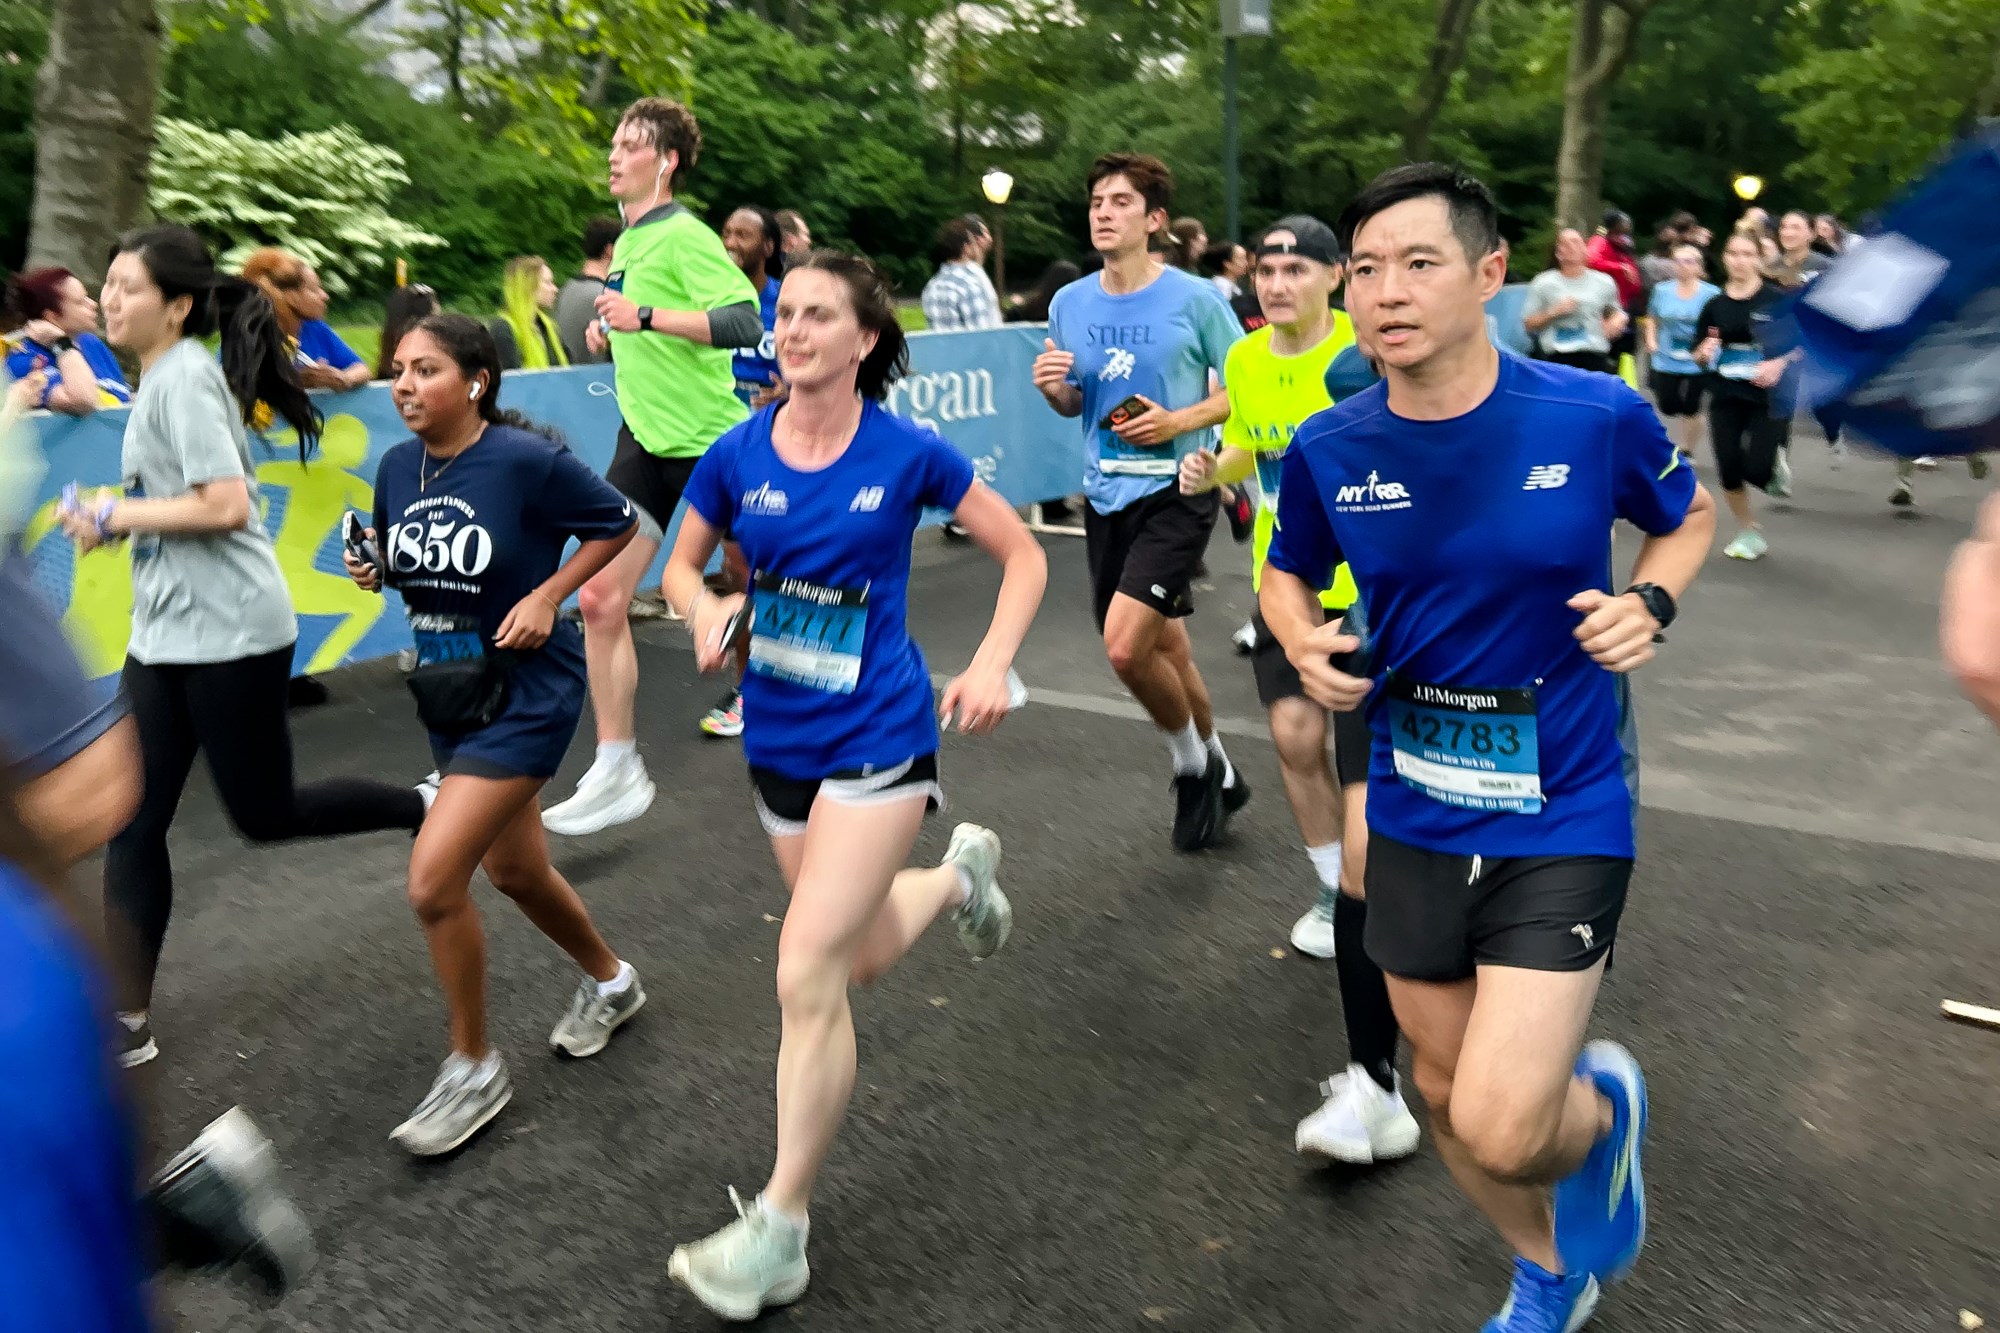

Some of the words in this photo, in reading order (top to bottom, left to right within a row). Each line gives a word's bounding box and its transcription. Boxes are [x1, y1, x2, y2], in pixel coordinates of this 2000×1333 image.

[1086, 323, 1157, 347] STIFEL
[387, 519, 493, 577] 1850
[1413, 684, 1498, 712] J.P.Morgan
[1401, 711, 1521, 756] 42783
